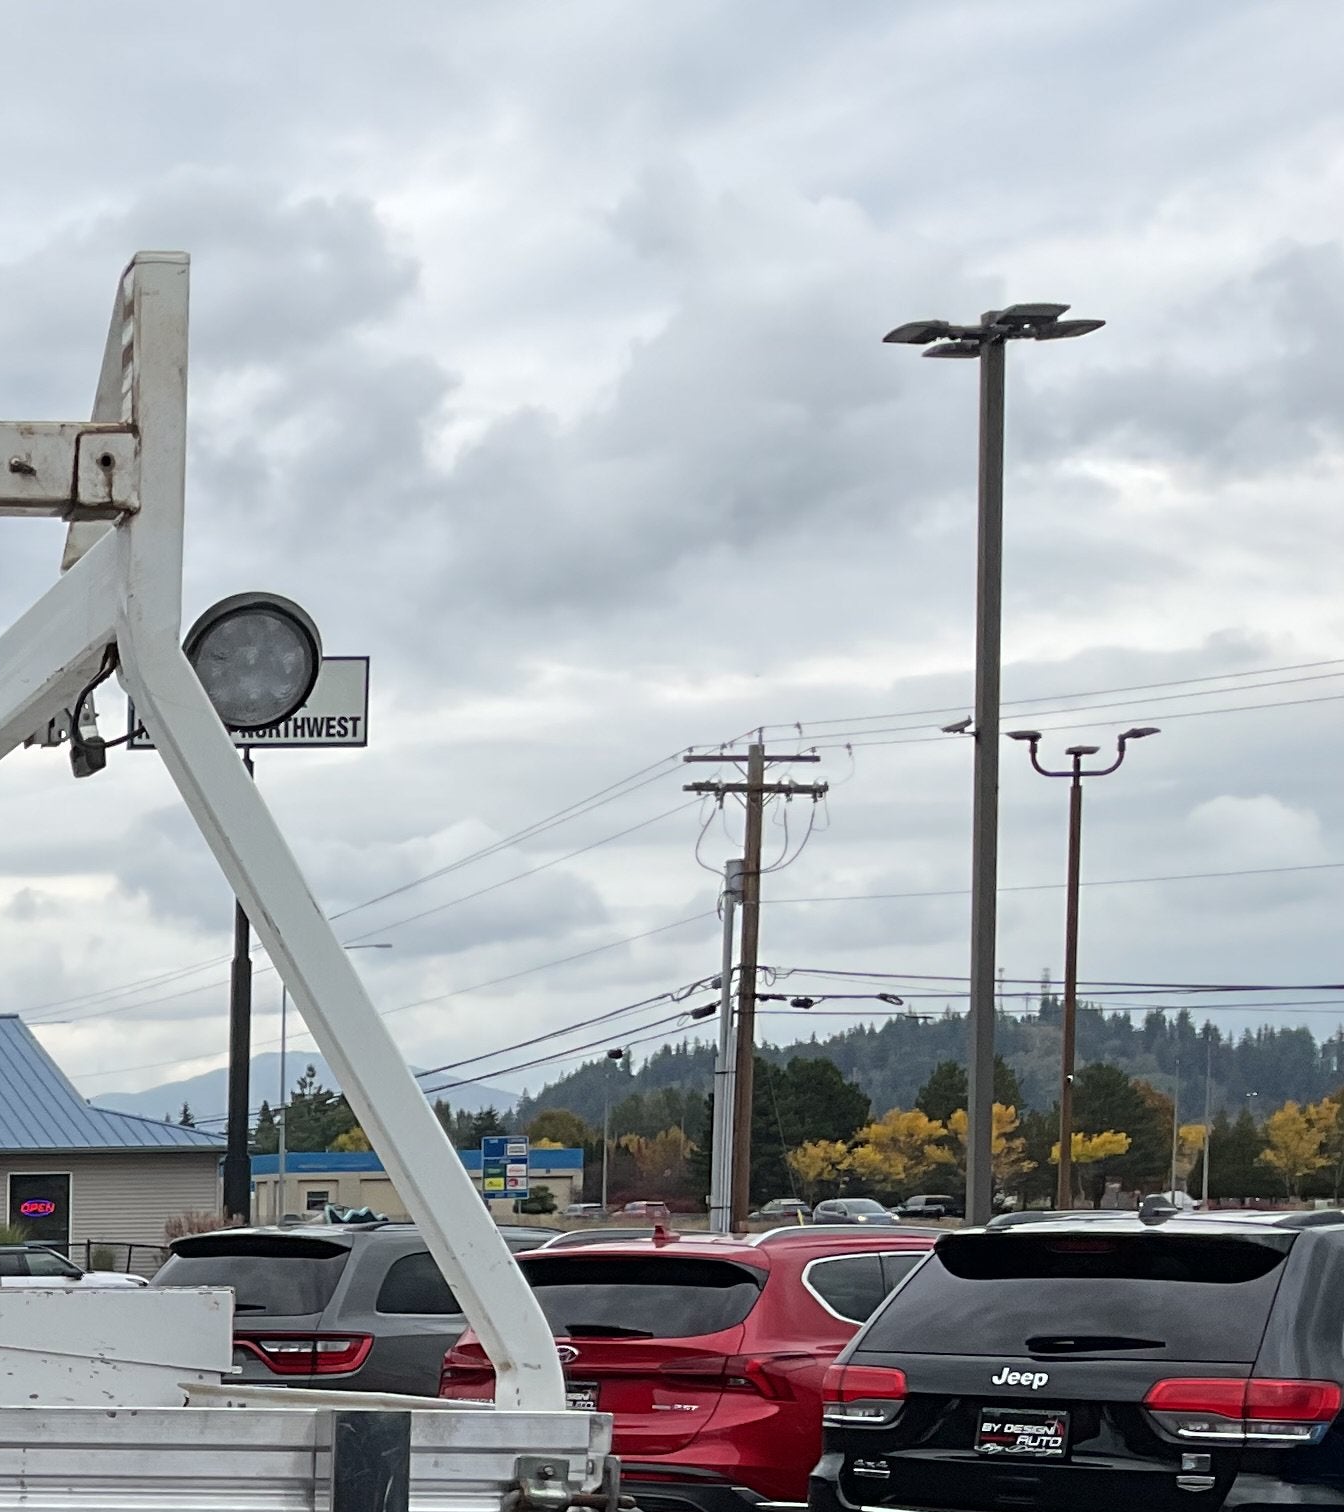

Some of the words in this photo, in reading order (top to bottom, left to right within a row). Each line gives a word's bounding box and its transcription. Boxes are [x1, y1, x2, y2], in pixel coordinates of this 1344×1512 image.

[20, 1201, 55, 1213] OPEN
[992, 1367, 1049, 1390] Jeep
[981, 1422, 1002, 1432] BY
[1003, 1424, 1056, 1435] DESIGN
[1016, 1435, 1063, 1447] AUTO
